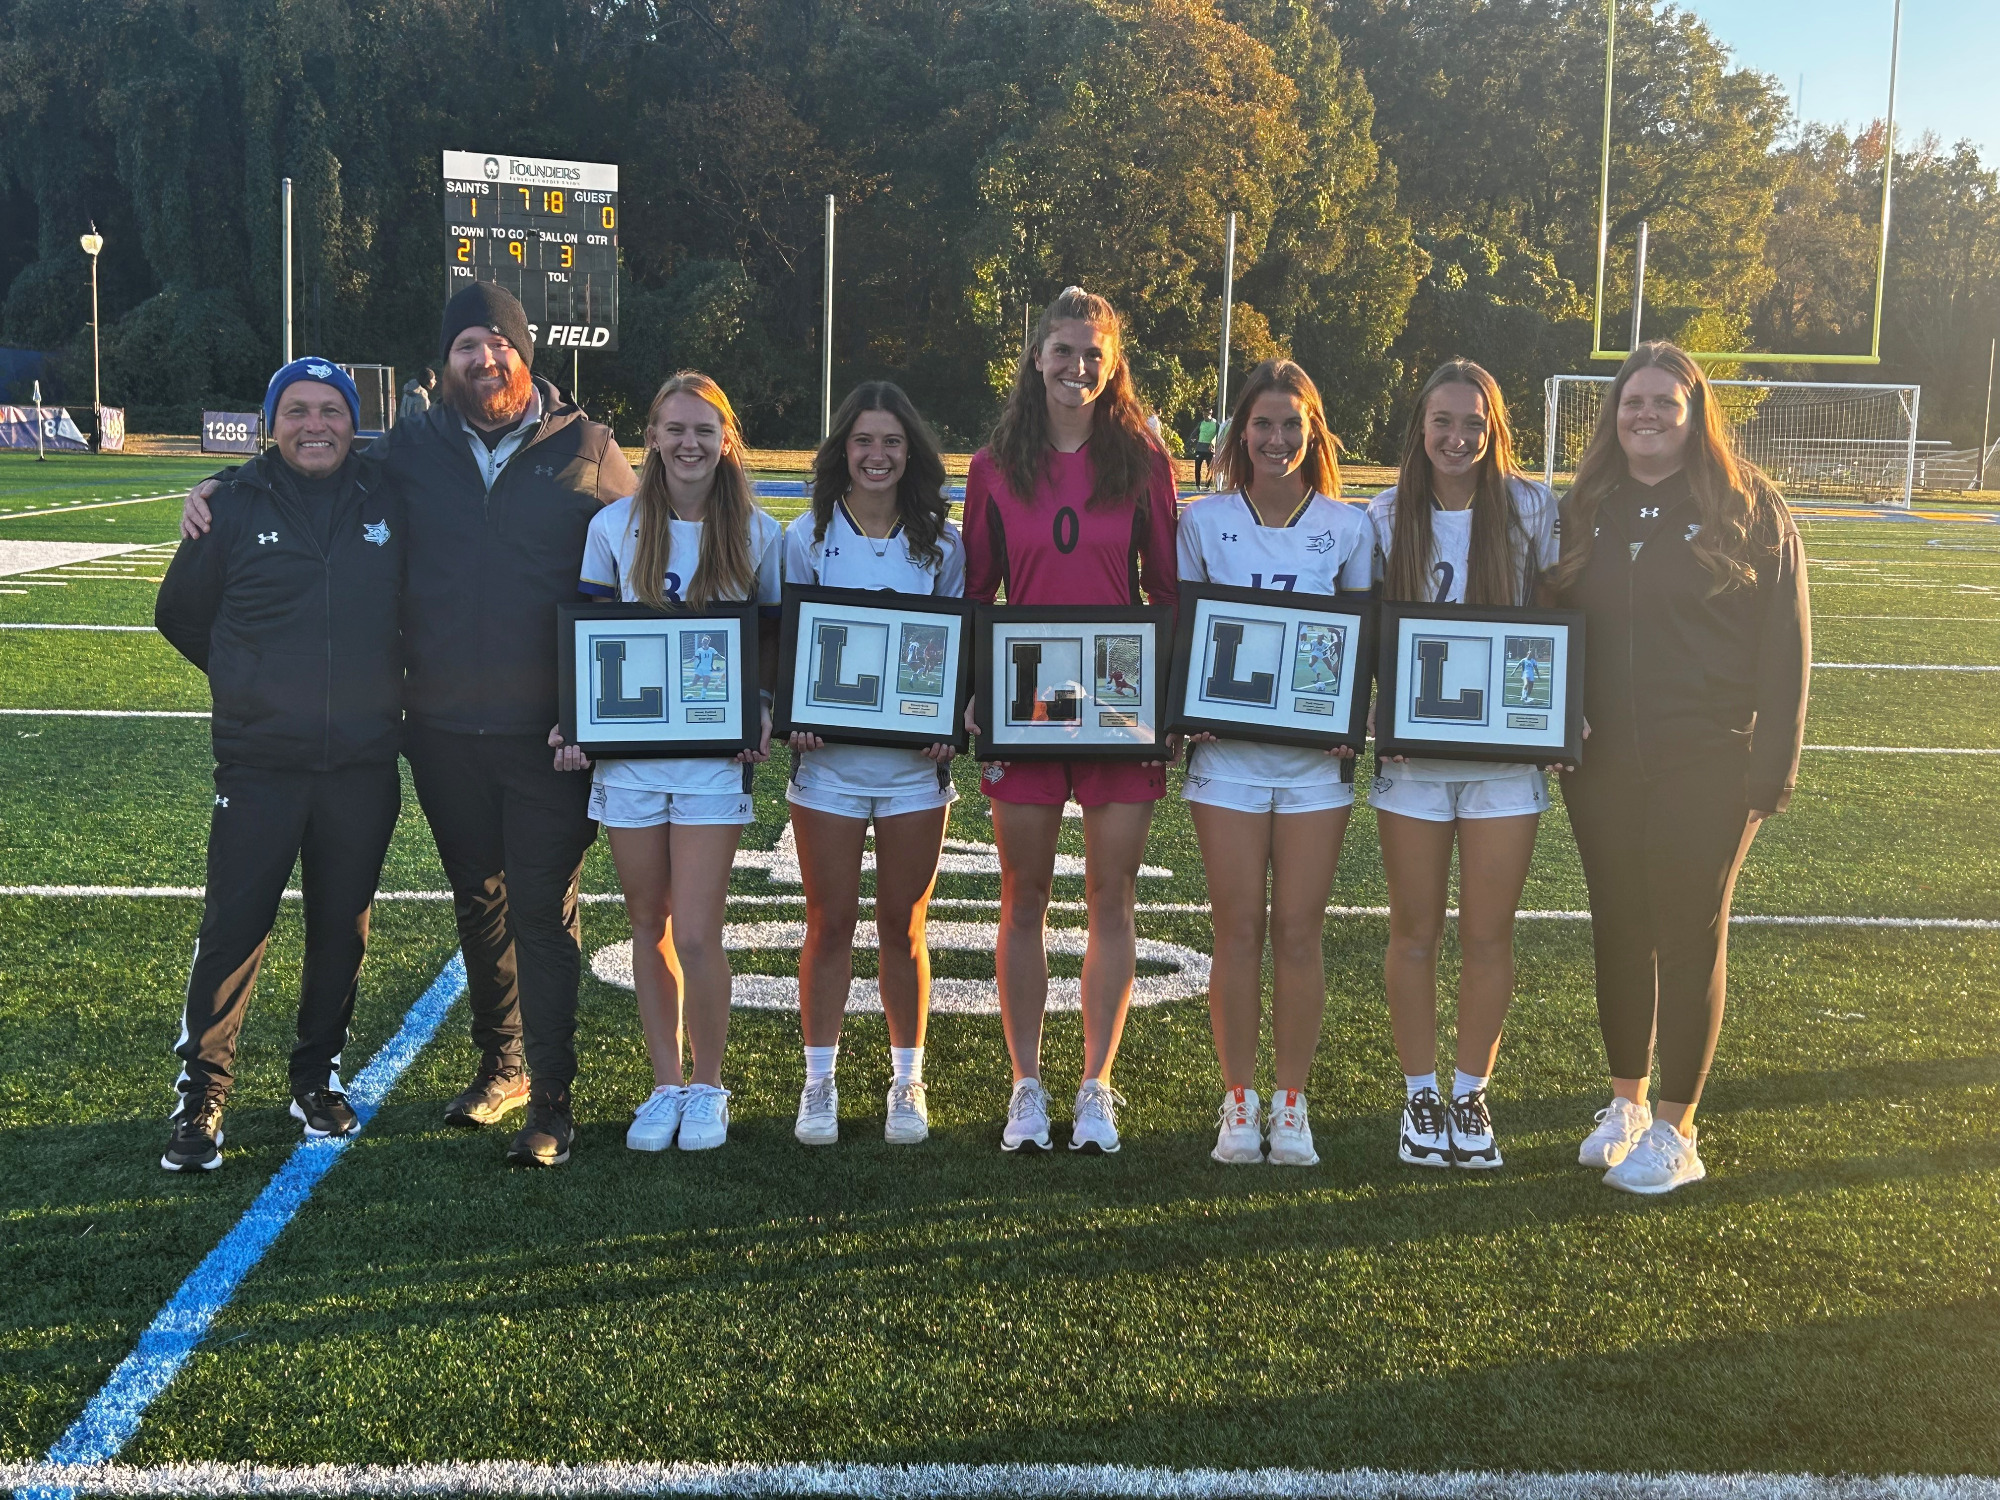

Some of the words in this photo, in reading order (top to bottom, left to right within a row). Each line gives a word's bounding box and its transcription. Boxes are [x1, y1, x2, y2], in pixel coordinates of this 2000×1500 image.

[510, 160, 580, 180] FOUNDERS
[446, 181, 490, 195] SAINTS
[574, 191, 612, 204] GUEST
[471, 197, 477, 218] 1
[518, 187, 530, 210] 7
[543, 190, 564, 214] 18
[602, 206, 615, 229] 0
[451, 225, 484, 237] DOWN
[491, 228, 506, 238] TO
[508, 229, 524, 239] GO
[564, 233, 578, 244] ON
[586, 234, 608, 245] QTR
[457, 238, 471, 262] 2
[509, 241, 522, 264] 9
[561, 245, 572, 268] 3
[452, 266, 474, 277] TOL
[548, 272, 568, 283] TOL
[547, 325, 610, 347] FIELD
[206, 421, 248, 442] 1288
[1053, 506, 1079, 554] 0
[1251, 573, 1298, 592] 7
[1432, 561, 1457, 603] 2
[813, 624, 880, 707] L
[1207, 622, 1274, 704] L
[596, 640, 663, 718] L
[1012, 643, 1076, 721] L
[1415, 641, 1483, 720] L
